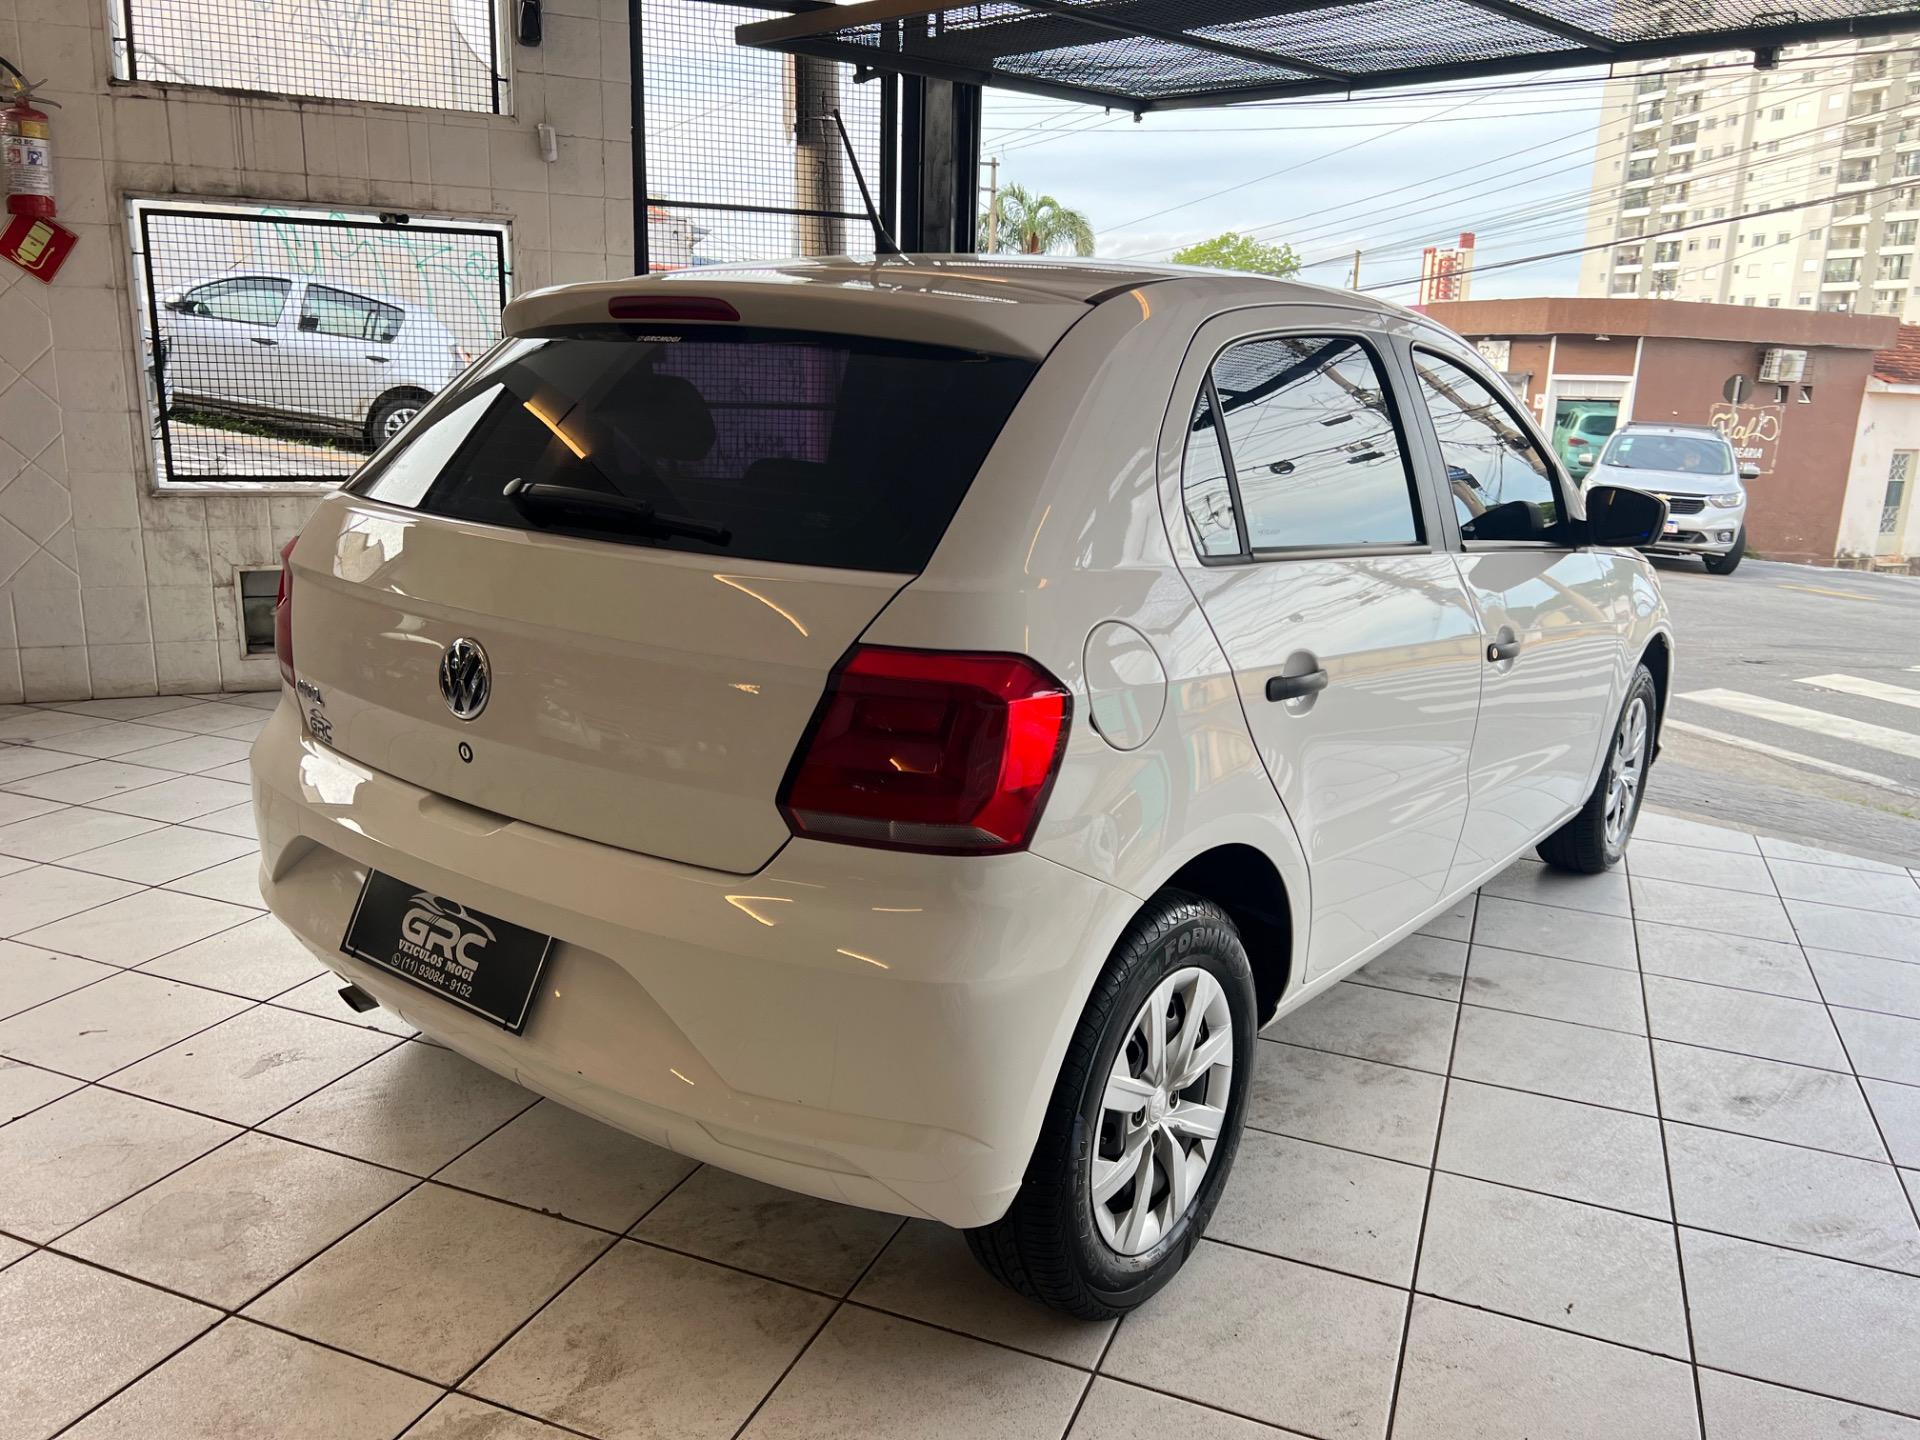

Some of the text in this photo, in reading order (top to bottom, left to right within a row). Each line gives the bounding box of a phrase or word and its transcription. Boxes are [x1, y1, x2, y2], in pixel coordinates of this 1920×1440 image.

[398, 939, 475, 982] VEICULOS MOGI
[401, 907, 488, 972] GRC
[400, 956, 419, 974] (11)
[418, 964, 445, 985] 93084
[449, 978, 473, 998] 9152
